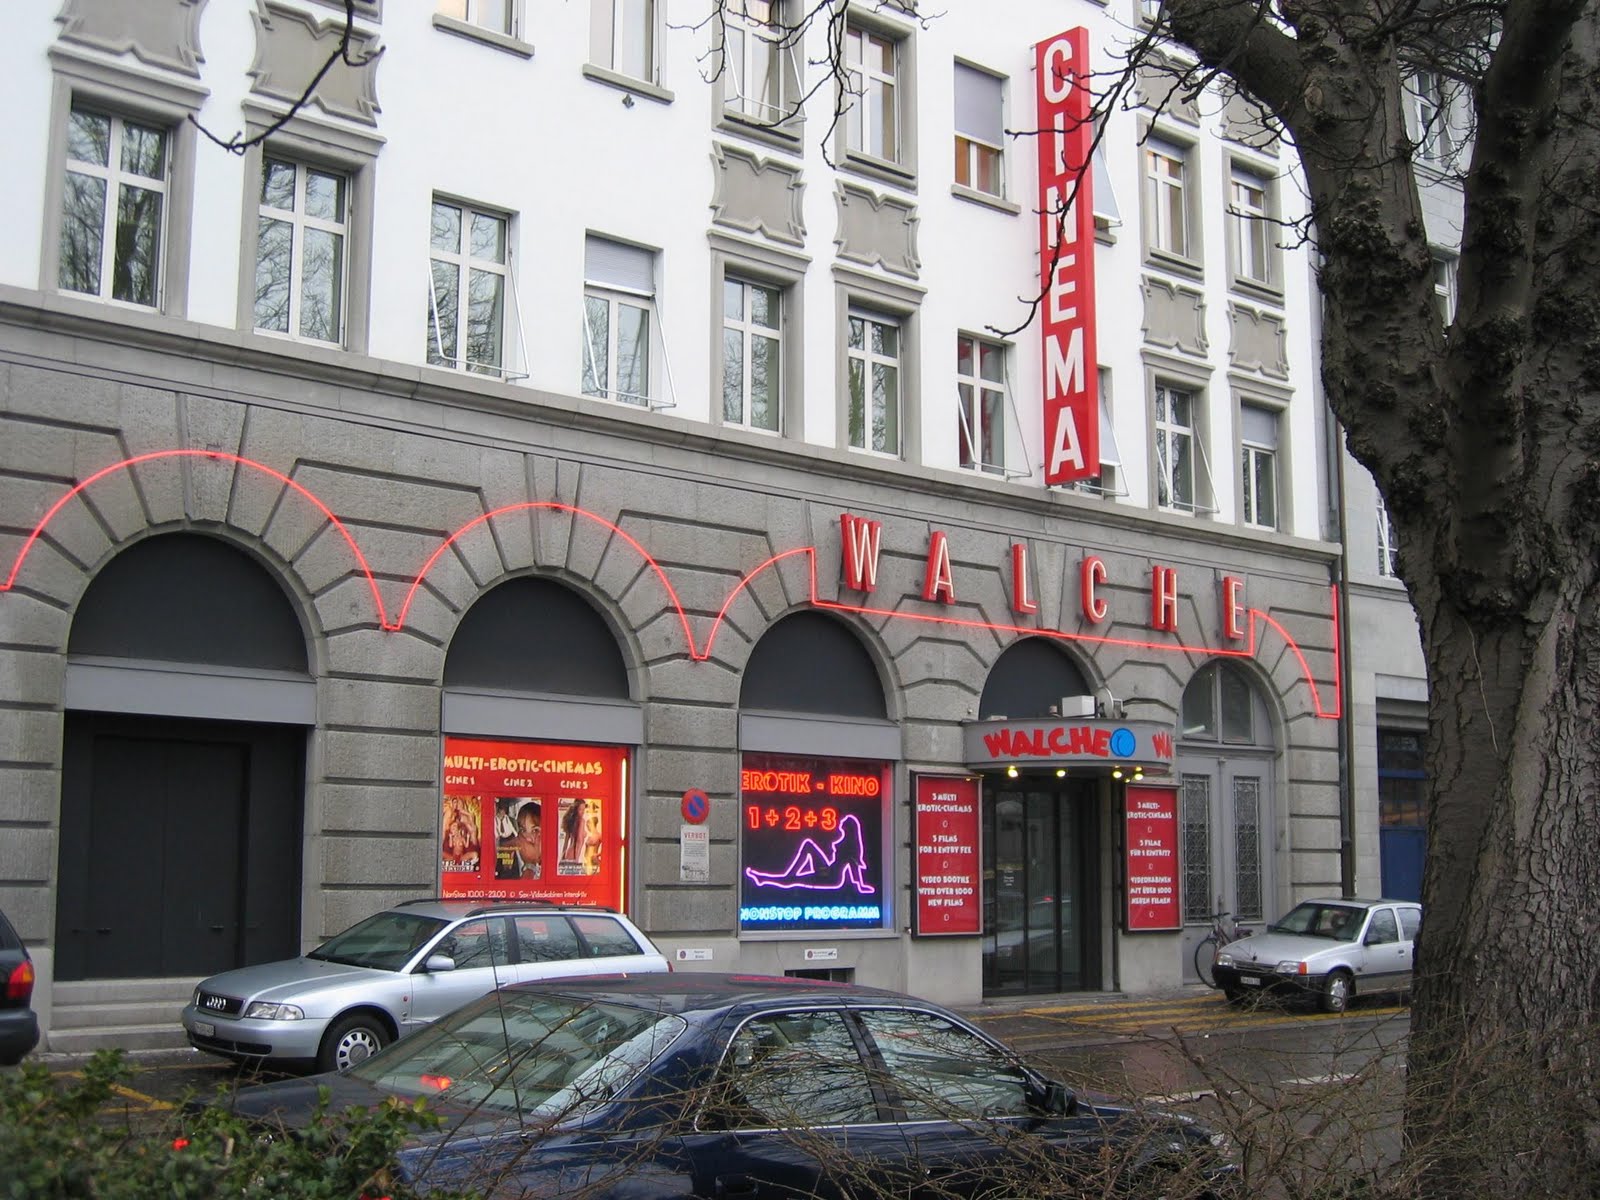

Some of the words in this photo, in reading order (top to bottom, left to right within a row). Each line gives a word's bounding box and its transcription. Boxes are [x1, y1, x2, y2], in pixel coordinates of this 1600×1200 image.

[1043, 38, 1085, 476] CINEMA
[840, 512, 1245, 641] WALCHE
[983, 726, 1112, 759] WALCHE
[444, 755, 603, 776] MULTI-EROTIC-CINEMAS
[445, 775, 470, 785] CINE
[503, 778, 527, 788] CINE
[560, 780, 582, 789] CINE
[741, 770, 811, 793] EROTIK
[830, 774, 879, 797] KINO
[917, 803, 972, 813] EROTIC-CINEMAS
[920, 846, 932, 854] FOR
[921, 875, 941, 883] VIDEO
[918, 887, 935, 895] WITH
[936, 887, 954, 895] OVER
[928, 899, 942, 907] NEW
[740, 906, 802, 921] NONSTOP
[804, 906, 880, 920] PROGRAMM
